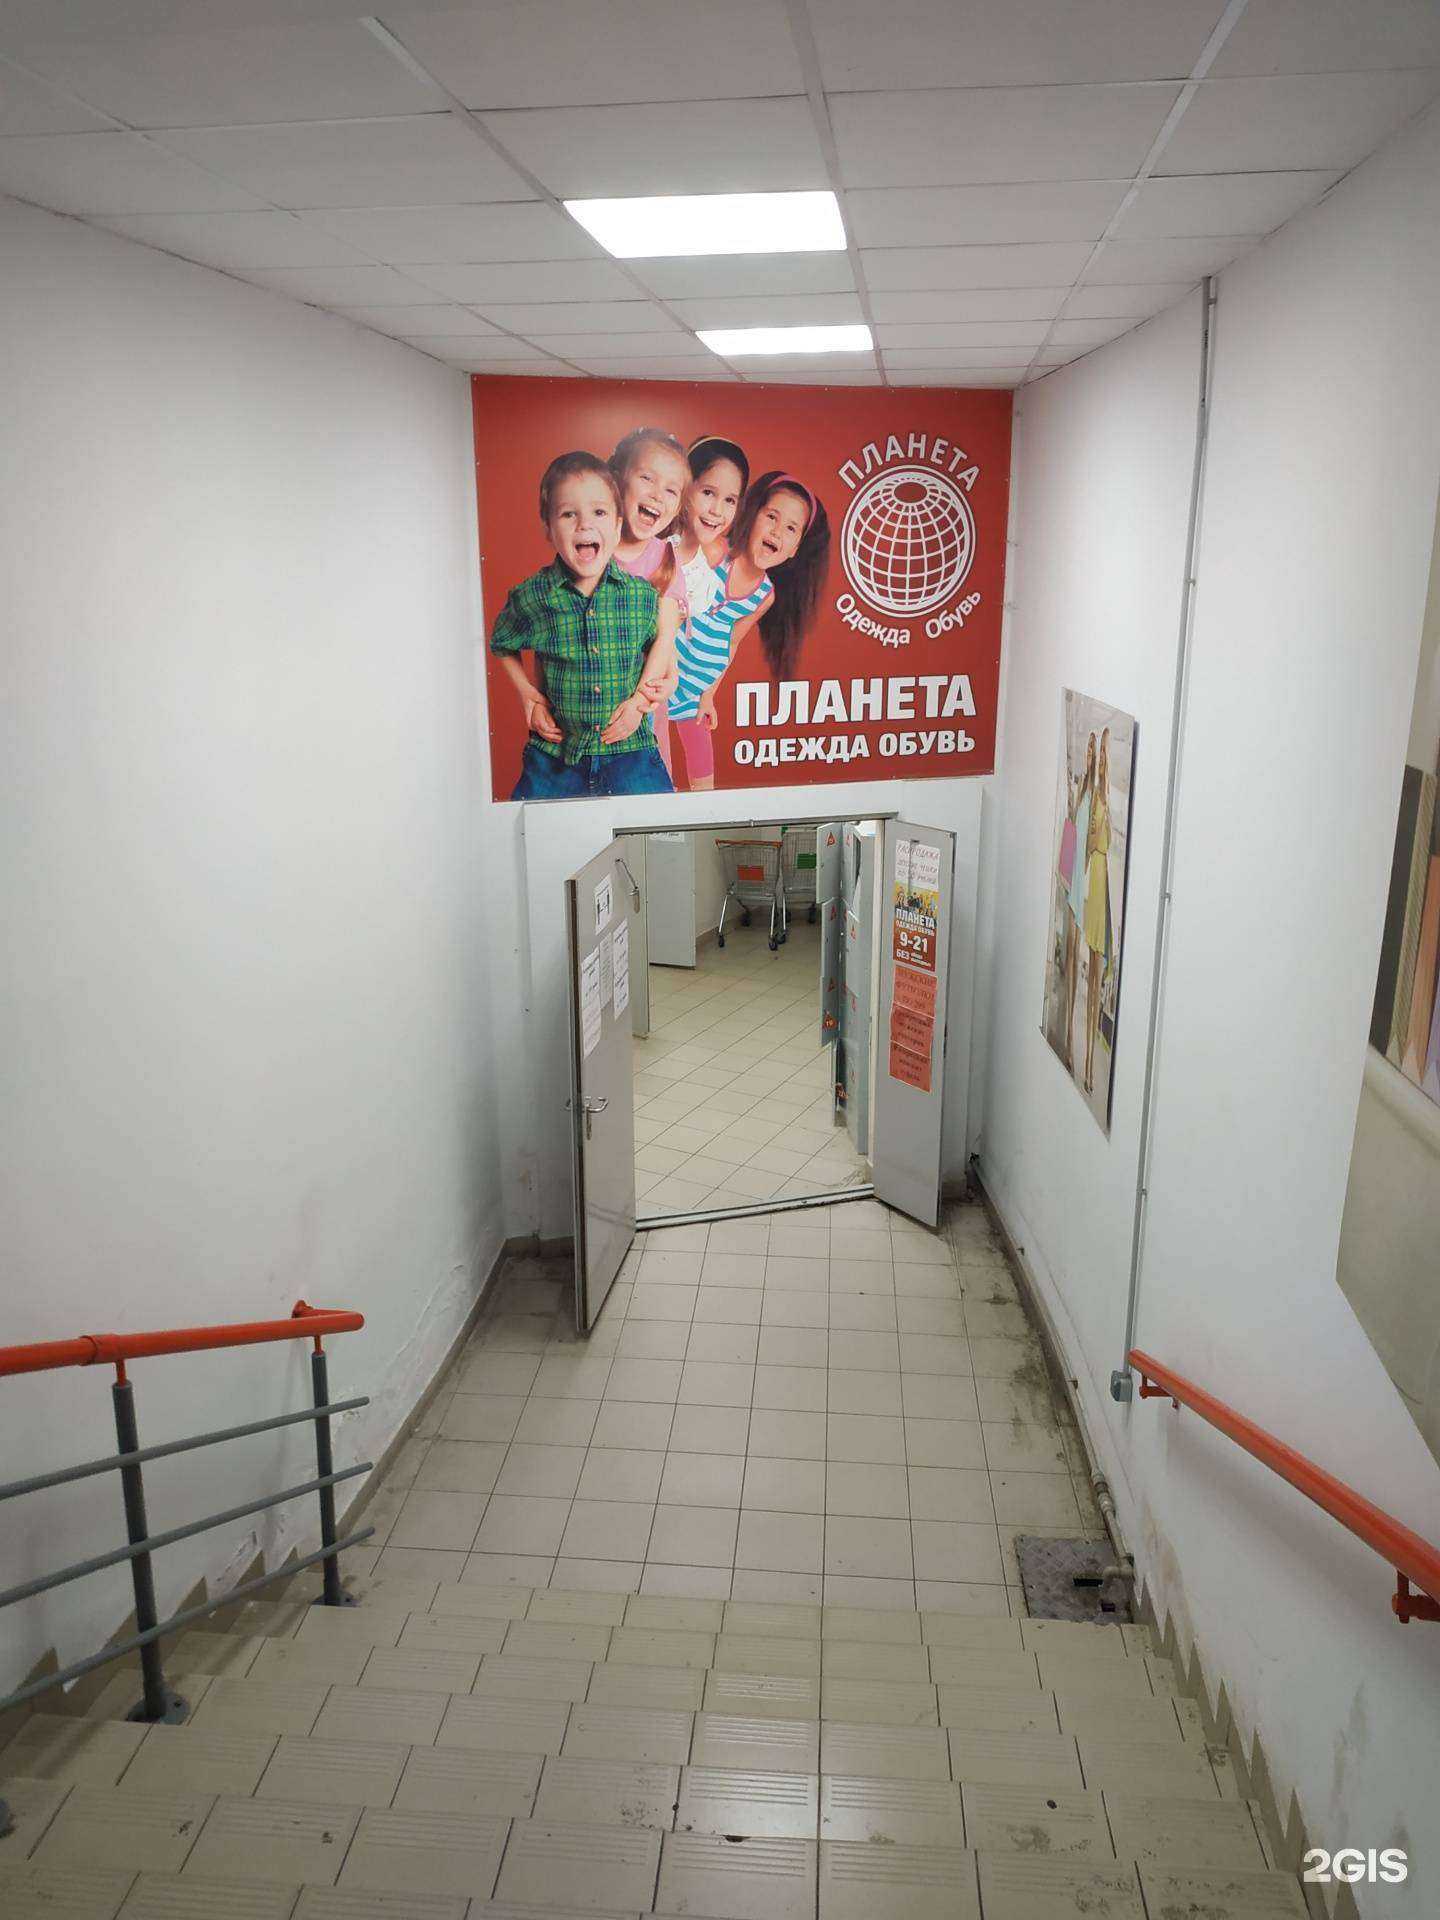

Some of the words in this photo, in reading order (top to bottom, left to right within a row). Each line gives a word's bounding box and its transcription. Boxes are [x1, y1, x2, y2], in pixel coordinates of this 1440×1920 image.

[838, 432, 981, 492] ПЛАНЕТА
[835, 593, 911, 648] Одежда
[925, 591, 981, 639] Обувь
[736, 674, 977, 727] ПЛАНЕТА
[734, 734, 871, 768] ОДЕЖДА
[878, 730, 976, 757] ОБУВЬ
[895, 907, 935, 929] ПЛАНЕТА
[899, 931, 928, 953] 9-21
